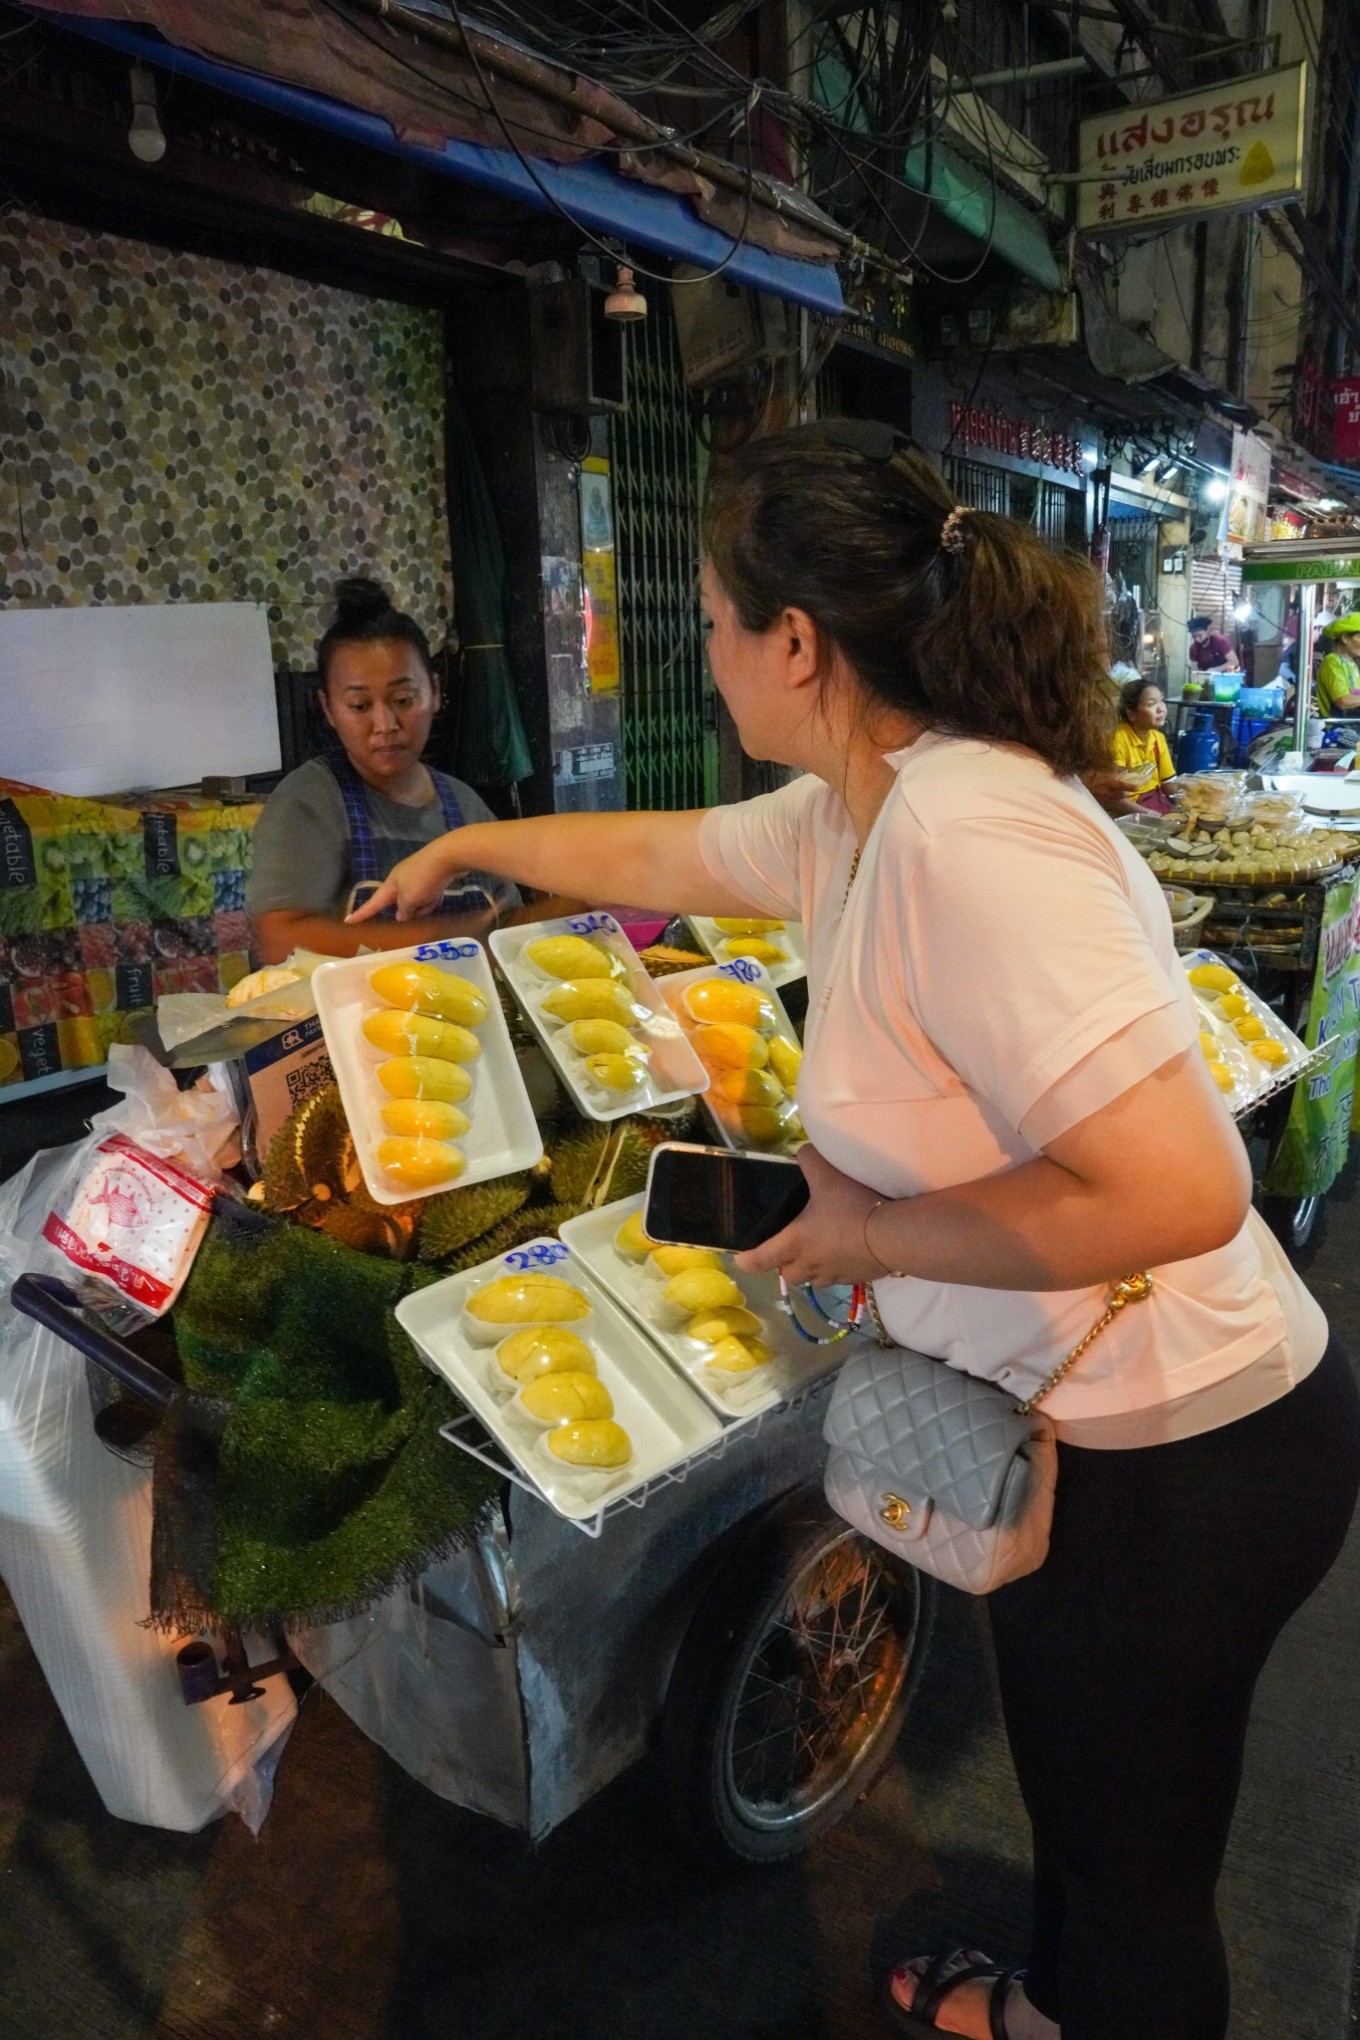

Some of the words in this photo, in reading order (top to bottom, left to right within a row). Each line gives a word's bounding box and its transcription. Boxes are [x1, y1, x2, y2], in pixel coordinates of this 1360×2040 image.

[1097, 92, 1275, 158] แสงอรุณ
[414, 940, 478, 962] 550
[126, 967, 145, 1005] fruit
[504, 1243, 569, 1270] 280
